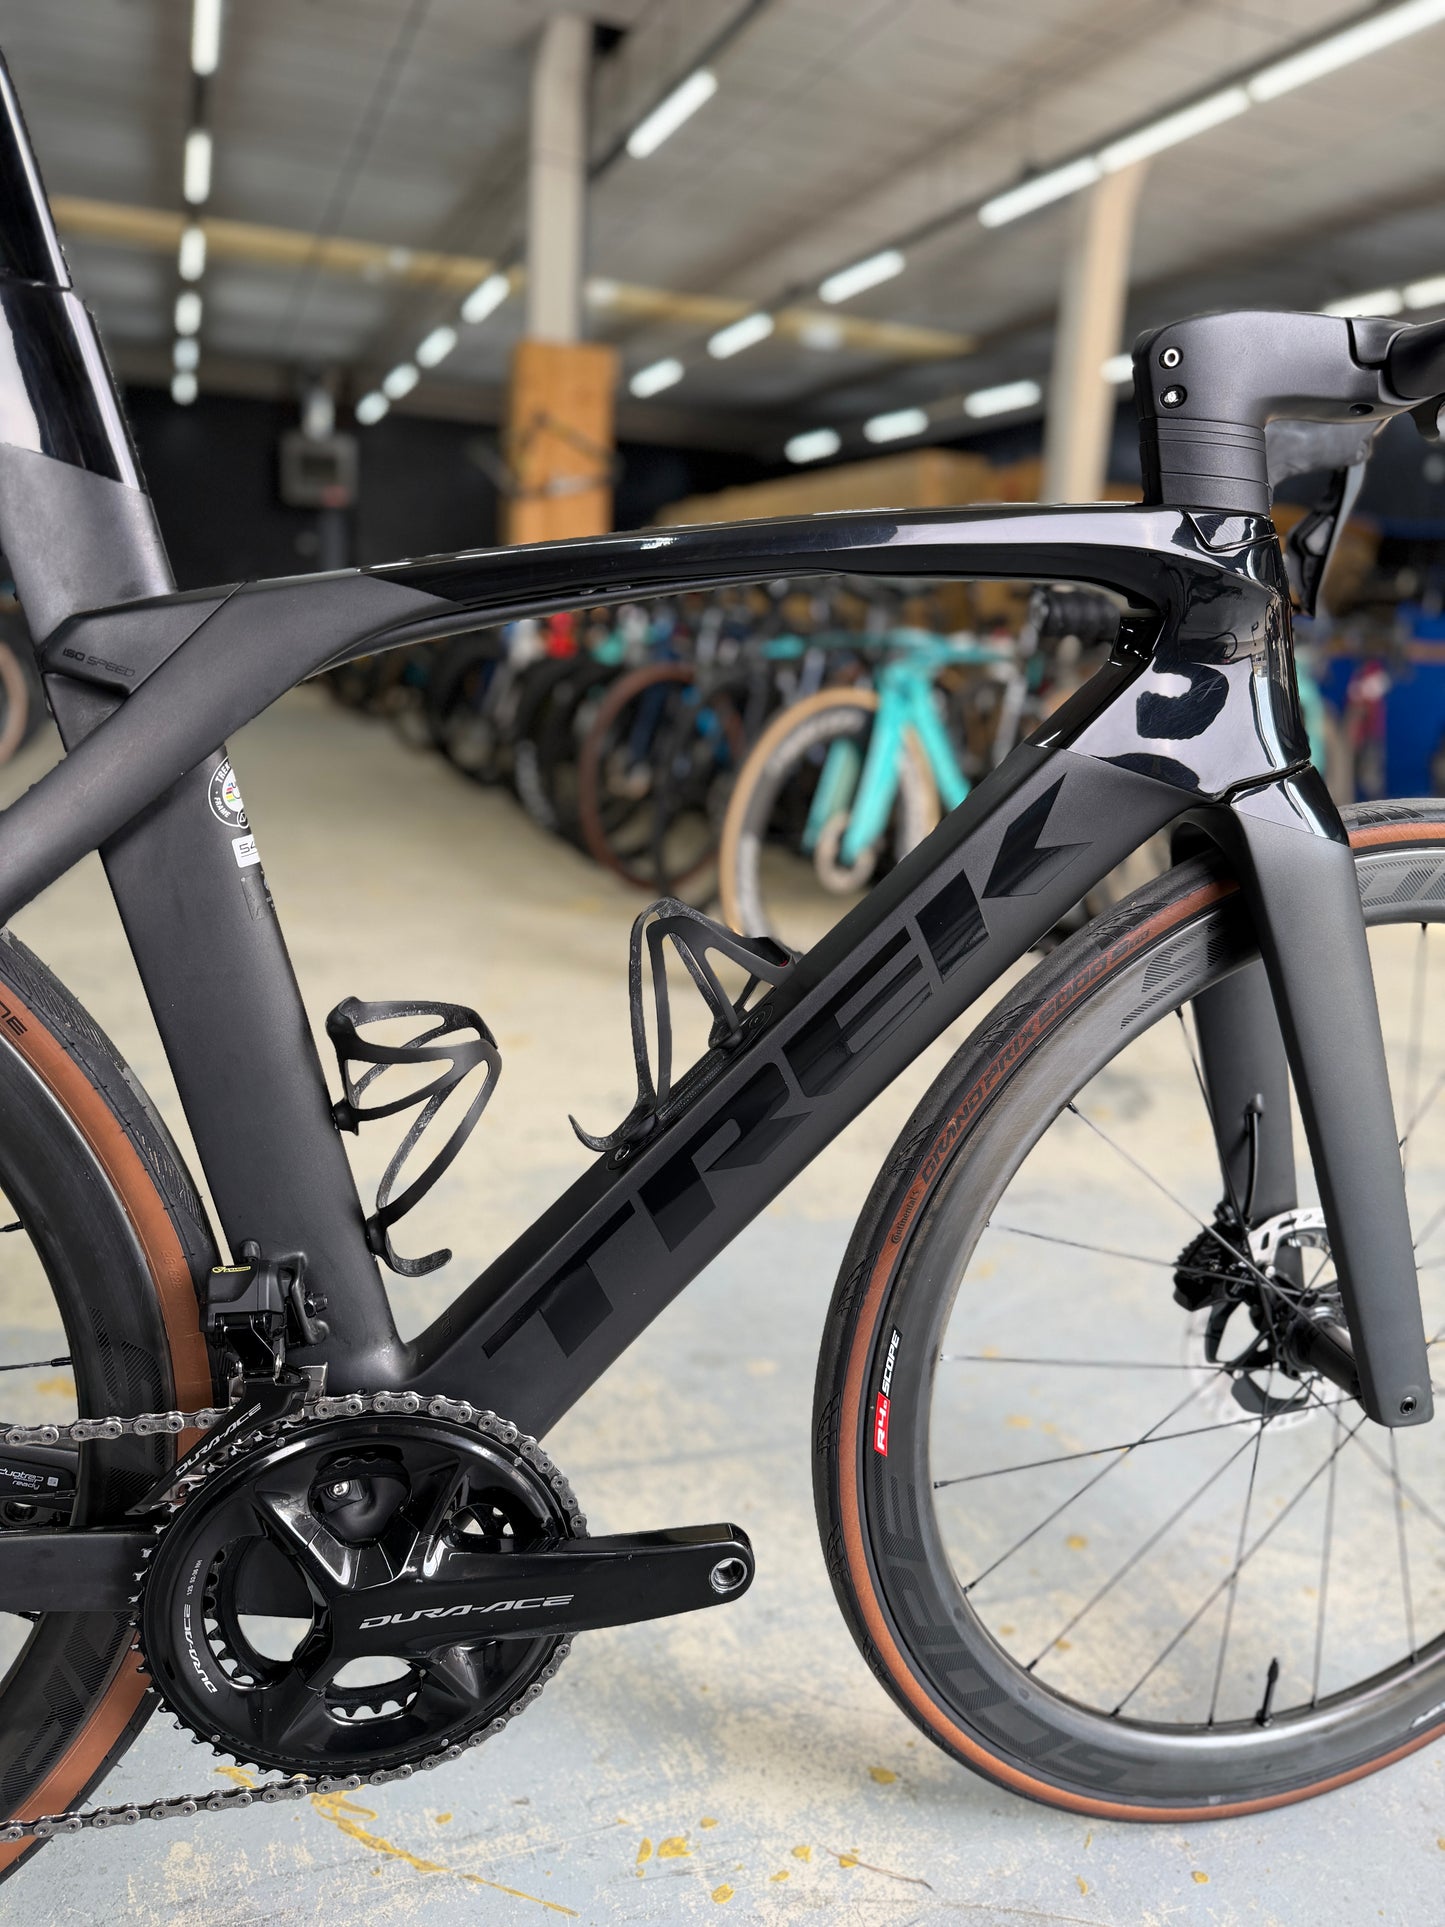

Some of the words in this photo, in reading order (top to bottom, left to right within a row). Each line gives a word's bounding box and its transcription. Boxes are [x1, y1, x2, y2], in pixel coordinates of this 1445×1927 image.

[63, 648, 85, 661] ISO
[87, 656, 135, 677] SPEED
[214, 797, 231, 818] FRAME
[482, 773, 1094, 1359] TREK
[921, 1084, 984, 1184] GRAND
[980, 1022, 1038, 1092] PRIX
[891, 1196, 919, 1244] Continental
[881, 1329, 900, 1397] SCOPE
[175, 1402, 262, 1476] DURA-ACE
[12, 1480, 40, 1490] ready
[359, 1594, 575, 1630] DURA-ACE
[183, 1604, 218, 1693] DURA-ACE
